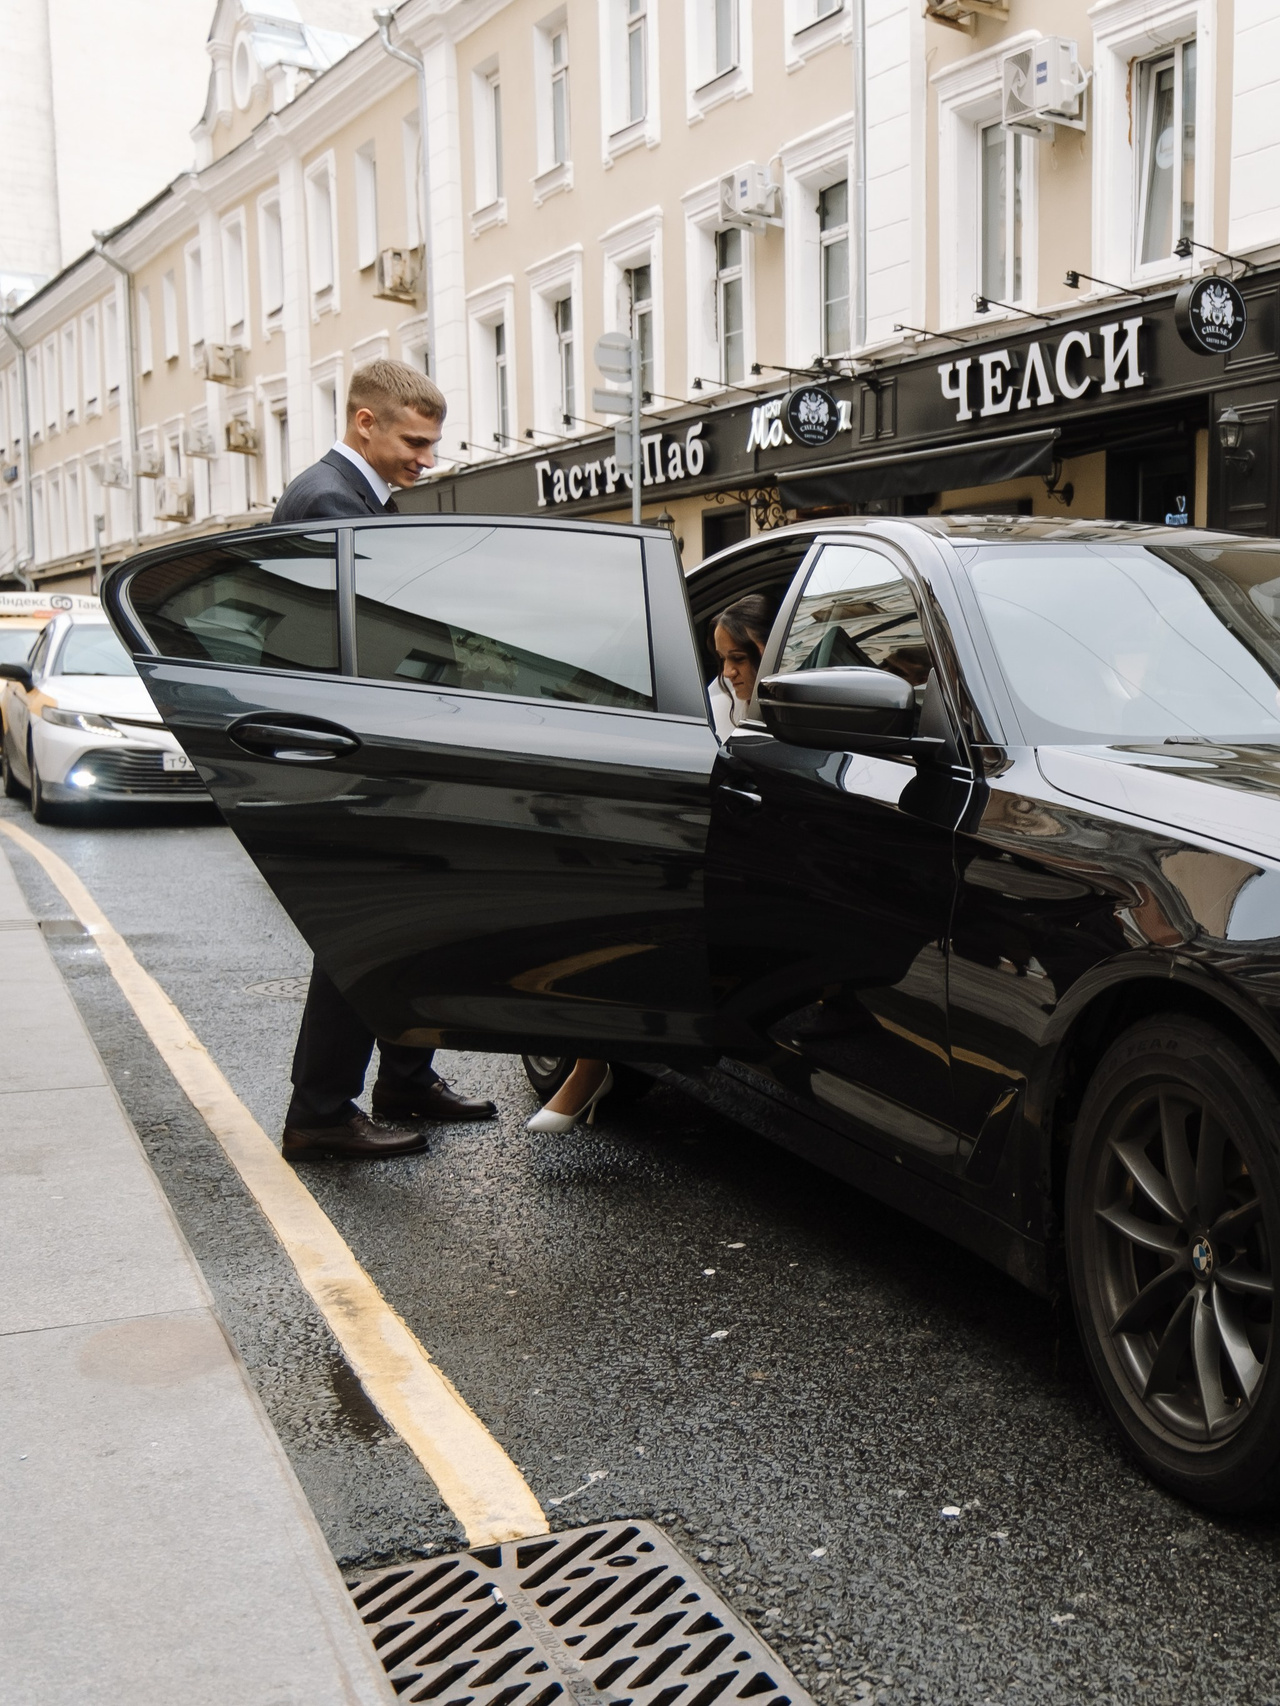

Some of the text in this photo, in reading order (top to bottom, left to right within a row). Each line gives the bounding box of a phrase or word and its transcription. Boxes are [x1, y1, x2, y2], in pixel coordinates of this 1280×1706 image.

[1201, 325, 1232, 340] CHELSEA
[938, 316, 1147, 422] ЧЕЛСИ
[800, 424, 828, 436] CHELSEA
